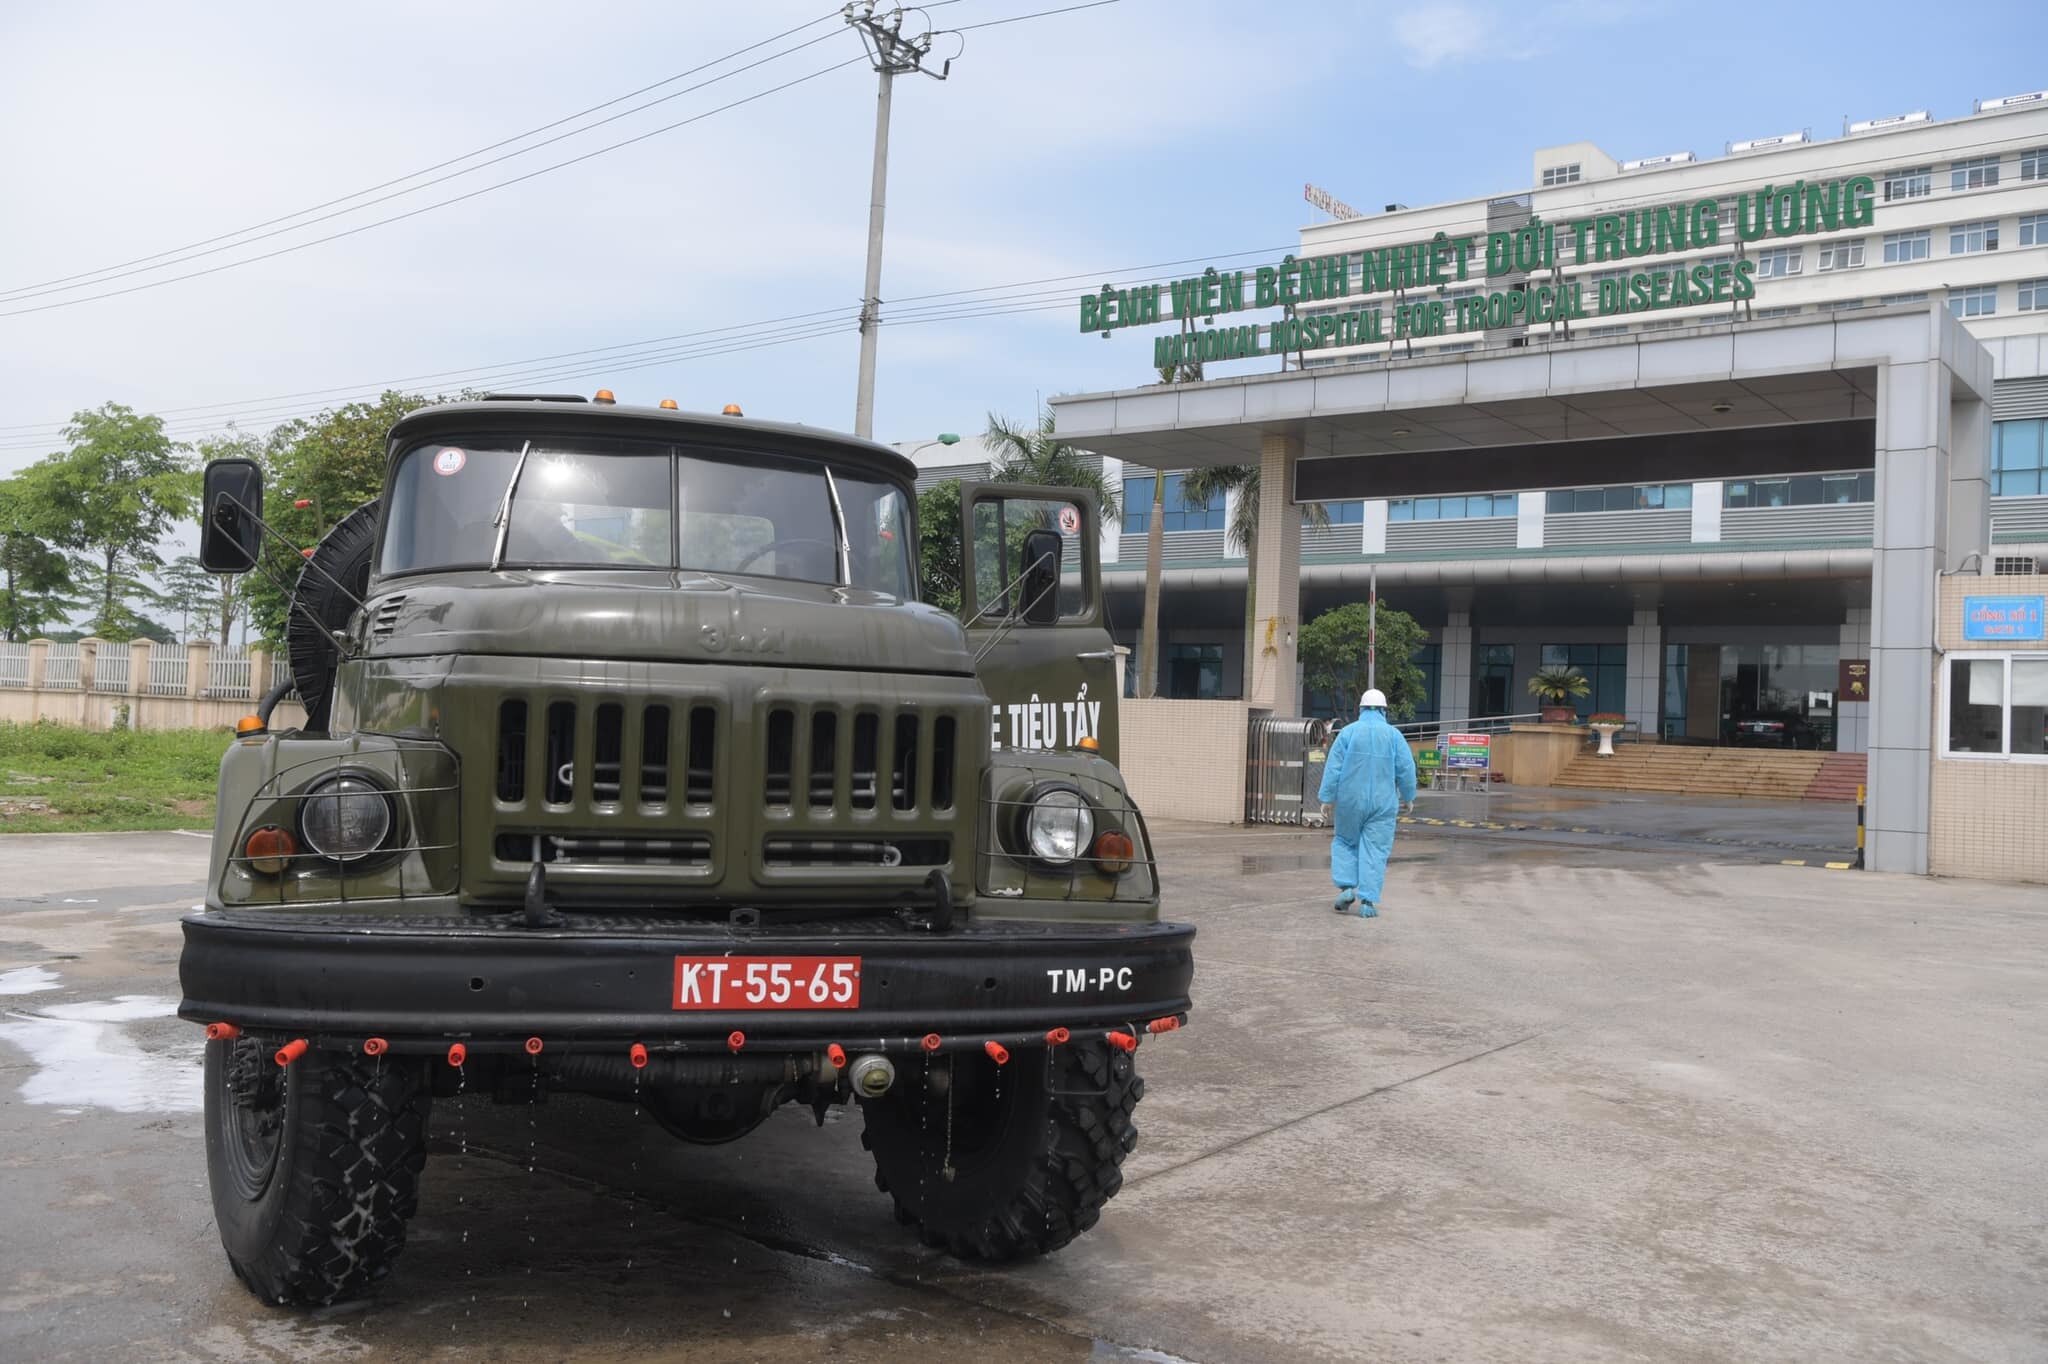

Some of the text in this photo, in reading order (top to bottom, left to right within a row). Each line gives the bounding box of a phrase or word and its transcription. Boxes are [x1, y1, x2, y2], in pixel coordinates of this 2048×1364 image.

[1080, 175, 1875, 339] BỆNH VIỆN BỆNH NHIỆT ĐỚI TRUNG ƯƠNG
[1154, 259, 1755, 368] NATIONAL HOSPITAL FOR TROPICAL DISEASES
[1008, 693, 1057, 750] TIÊU
[1062, 682, 1101, 747] TẨY
[681, 963, 854, 1003] KT-55-65
[1047, 967, 1132, 994] TM-PC
